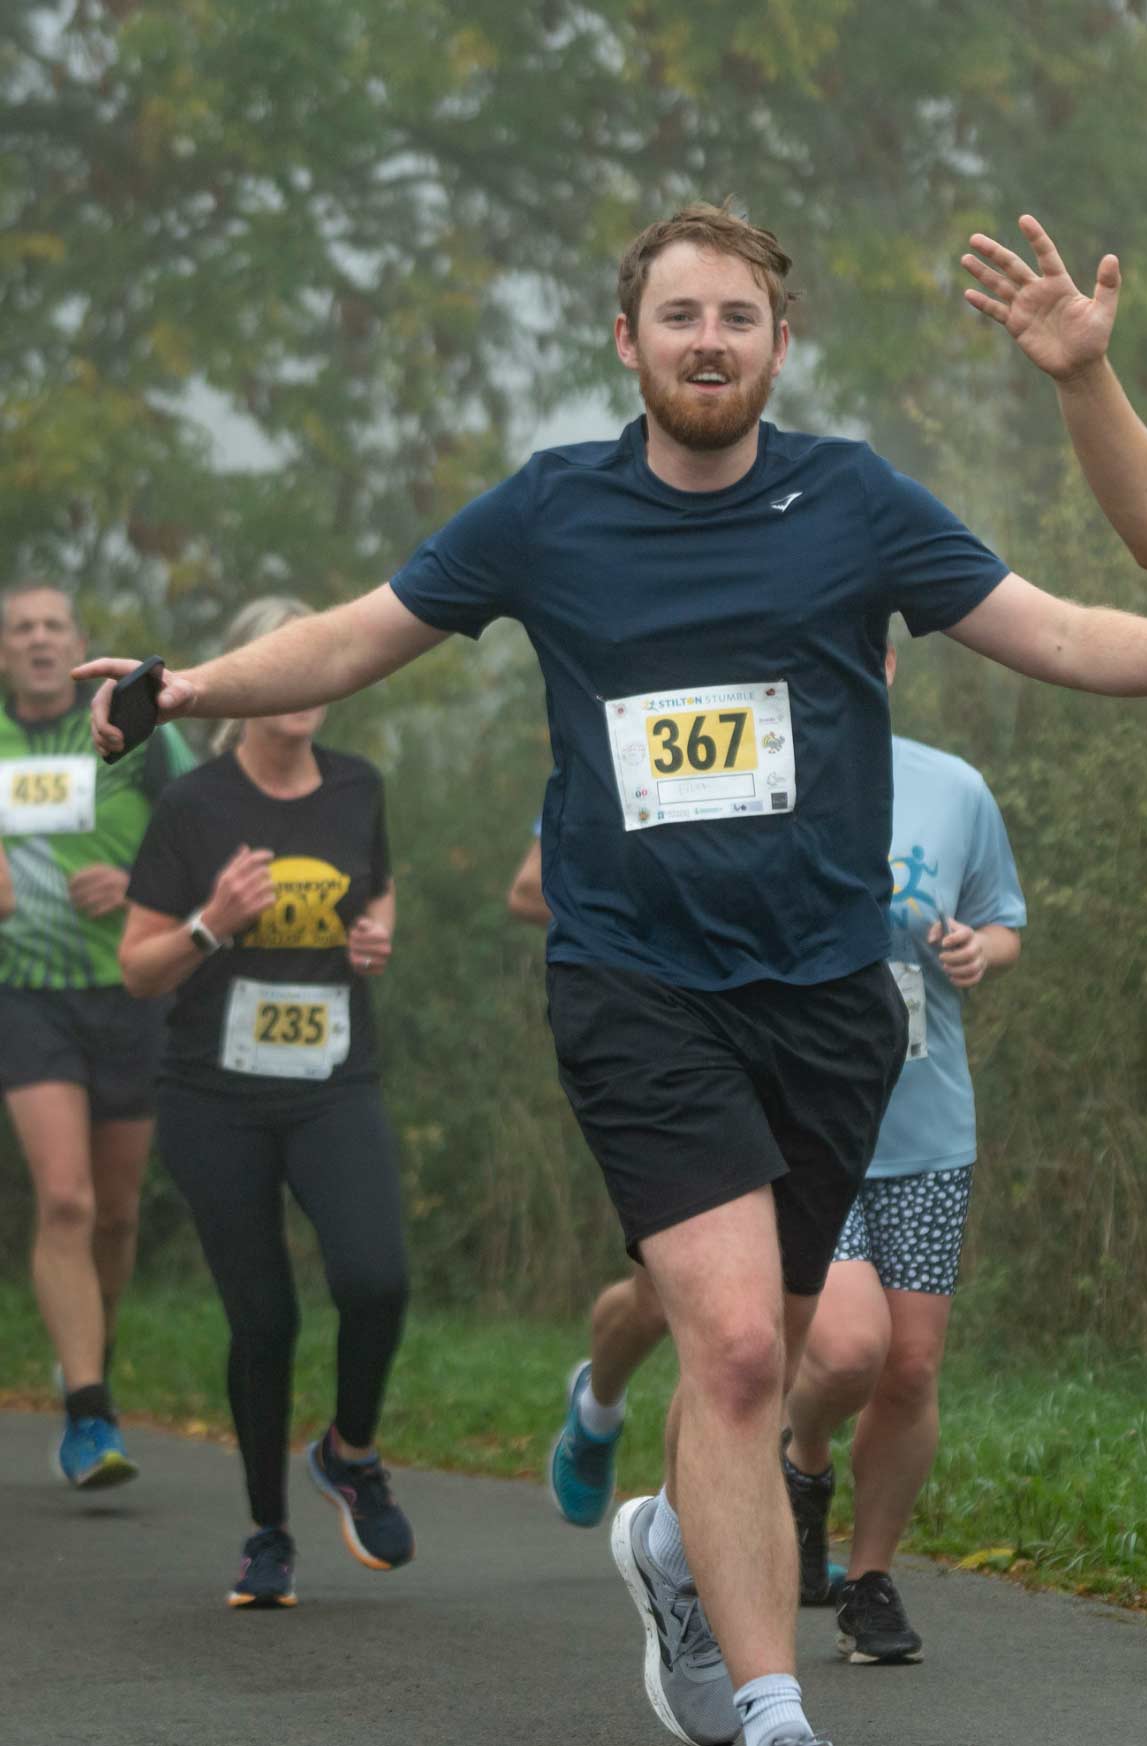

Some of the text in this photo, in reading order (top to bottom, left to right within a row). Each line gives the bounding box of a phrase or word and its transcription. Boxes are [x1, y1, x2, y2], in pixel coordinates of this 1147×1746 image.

[658, 691, 756, 709] STILTON STUMBLE
[652, 711, 748, 775] 367
[15, 773, 67, 804] 455
[258, 1003, 325, 1046] 235
